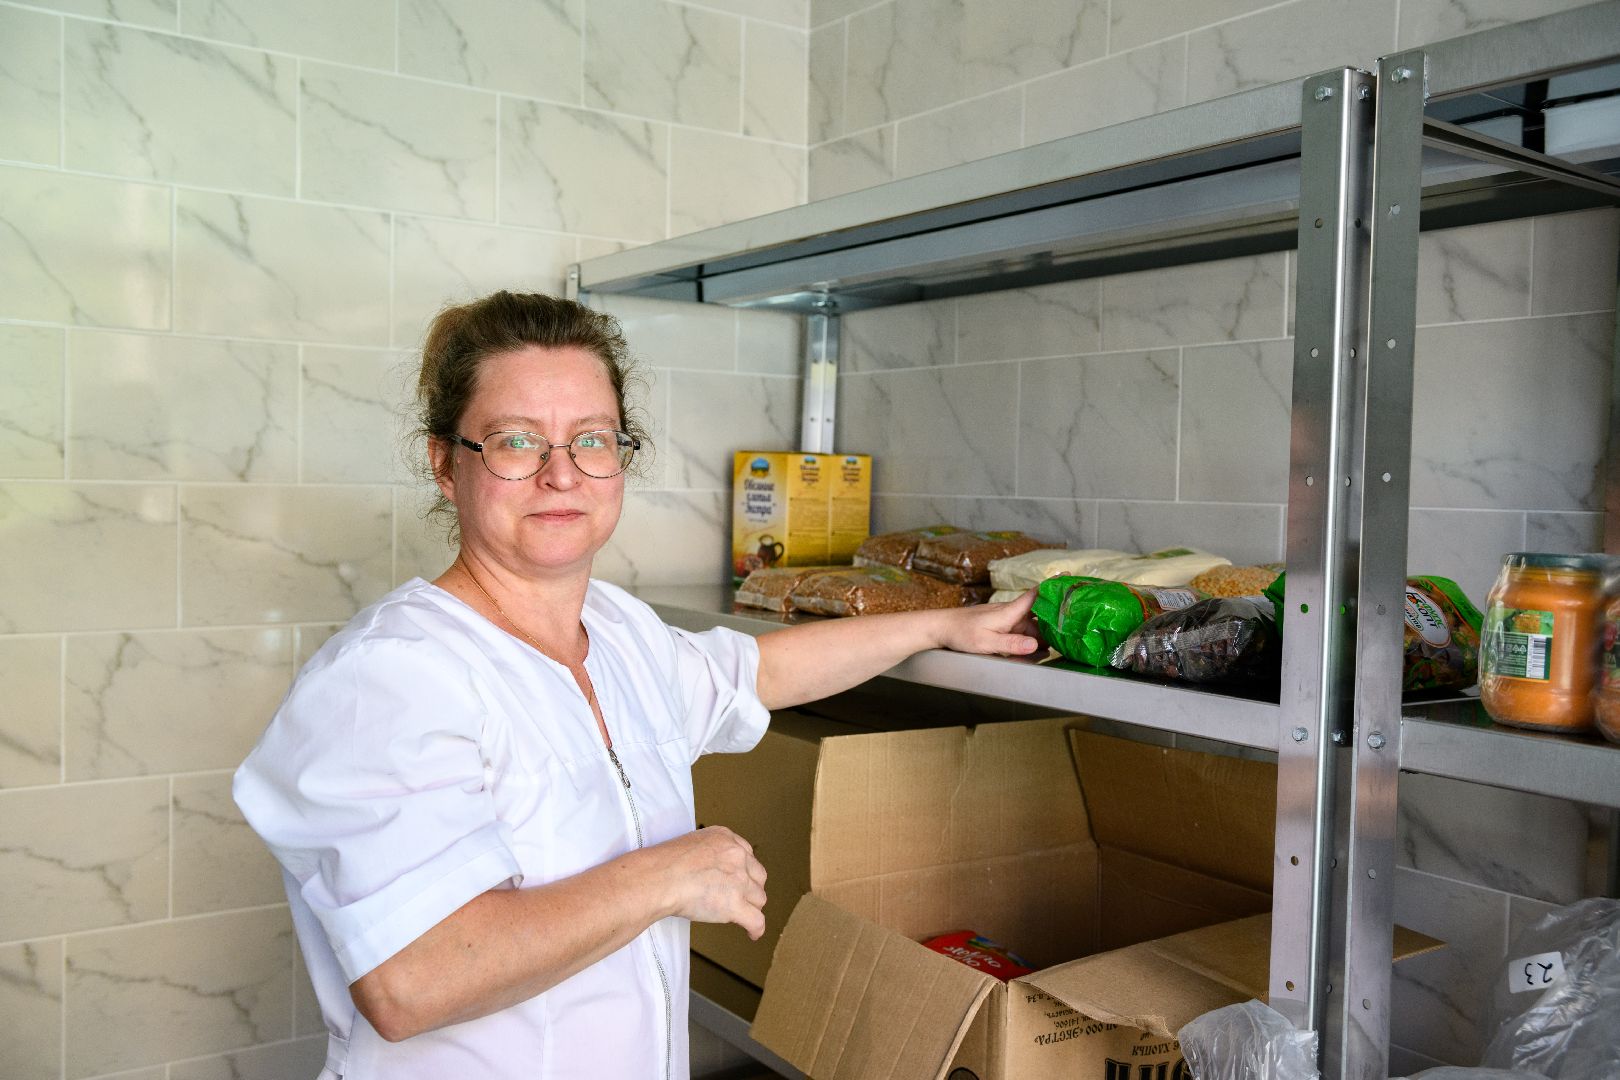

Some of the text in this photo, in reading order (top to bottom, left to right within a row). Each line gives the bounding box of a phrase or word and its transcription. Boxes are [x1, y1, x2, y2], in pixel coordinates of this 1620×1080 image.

[1524, 962, 1553, 985] 23
[1034, 1027, 1083, 1046] «ЭКСТРА»
[1132, 1041, 1171, 1057] ХЛОПЬЯ
